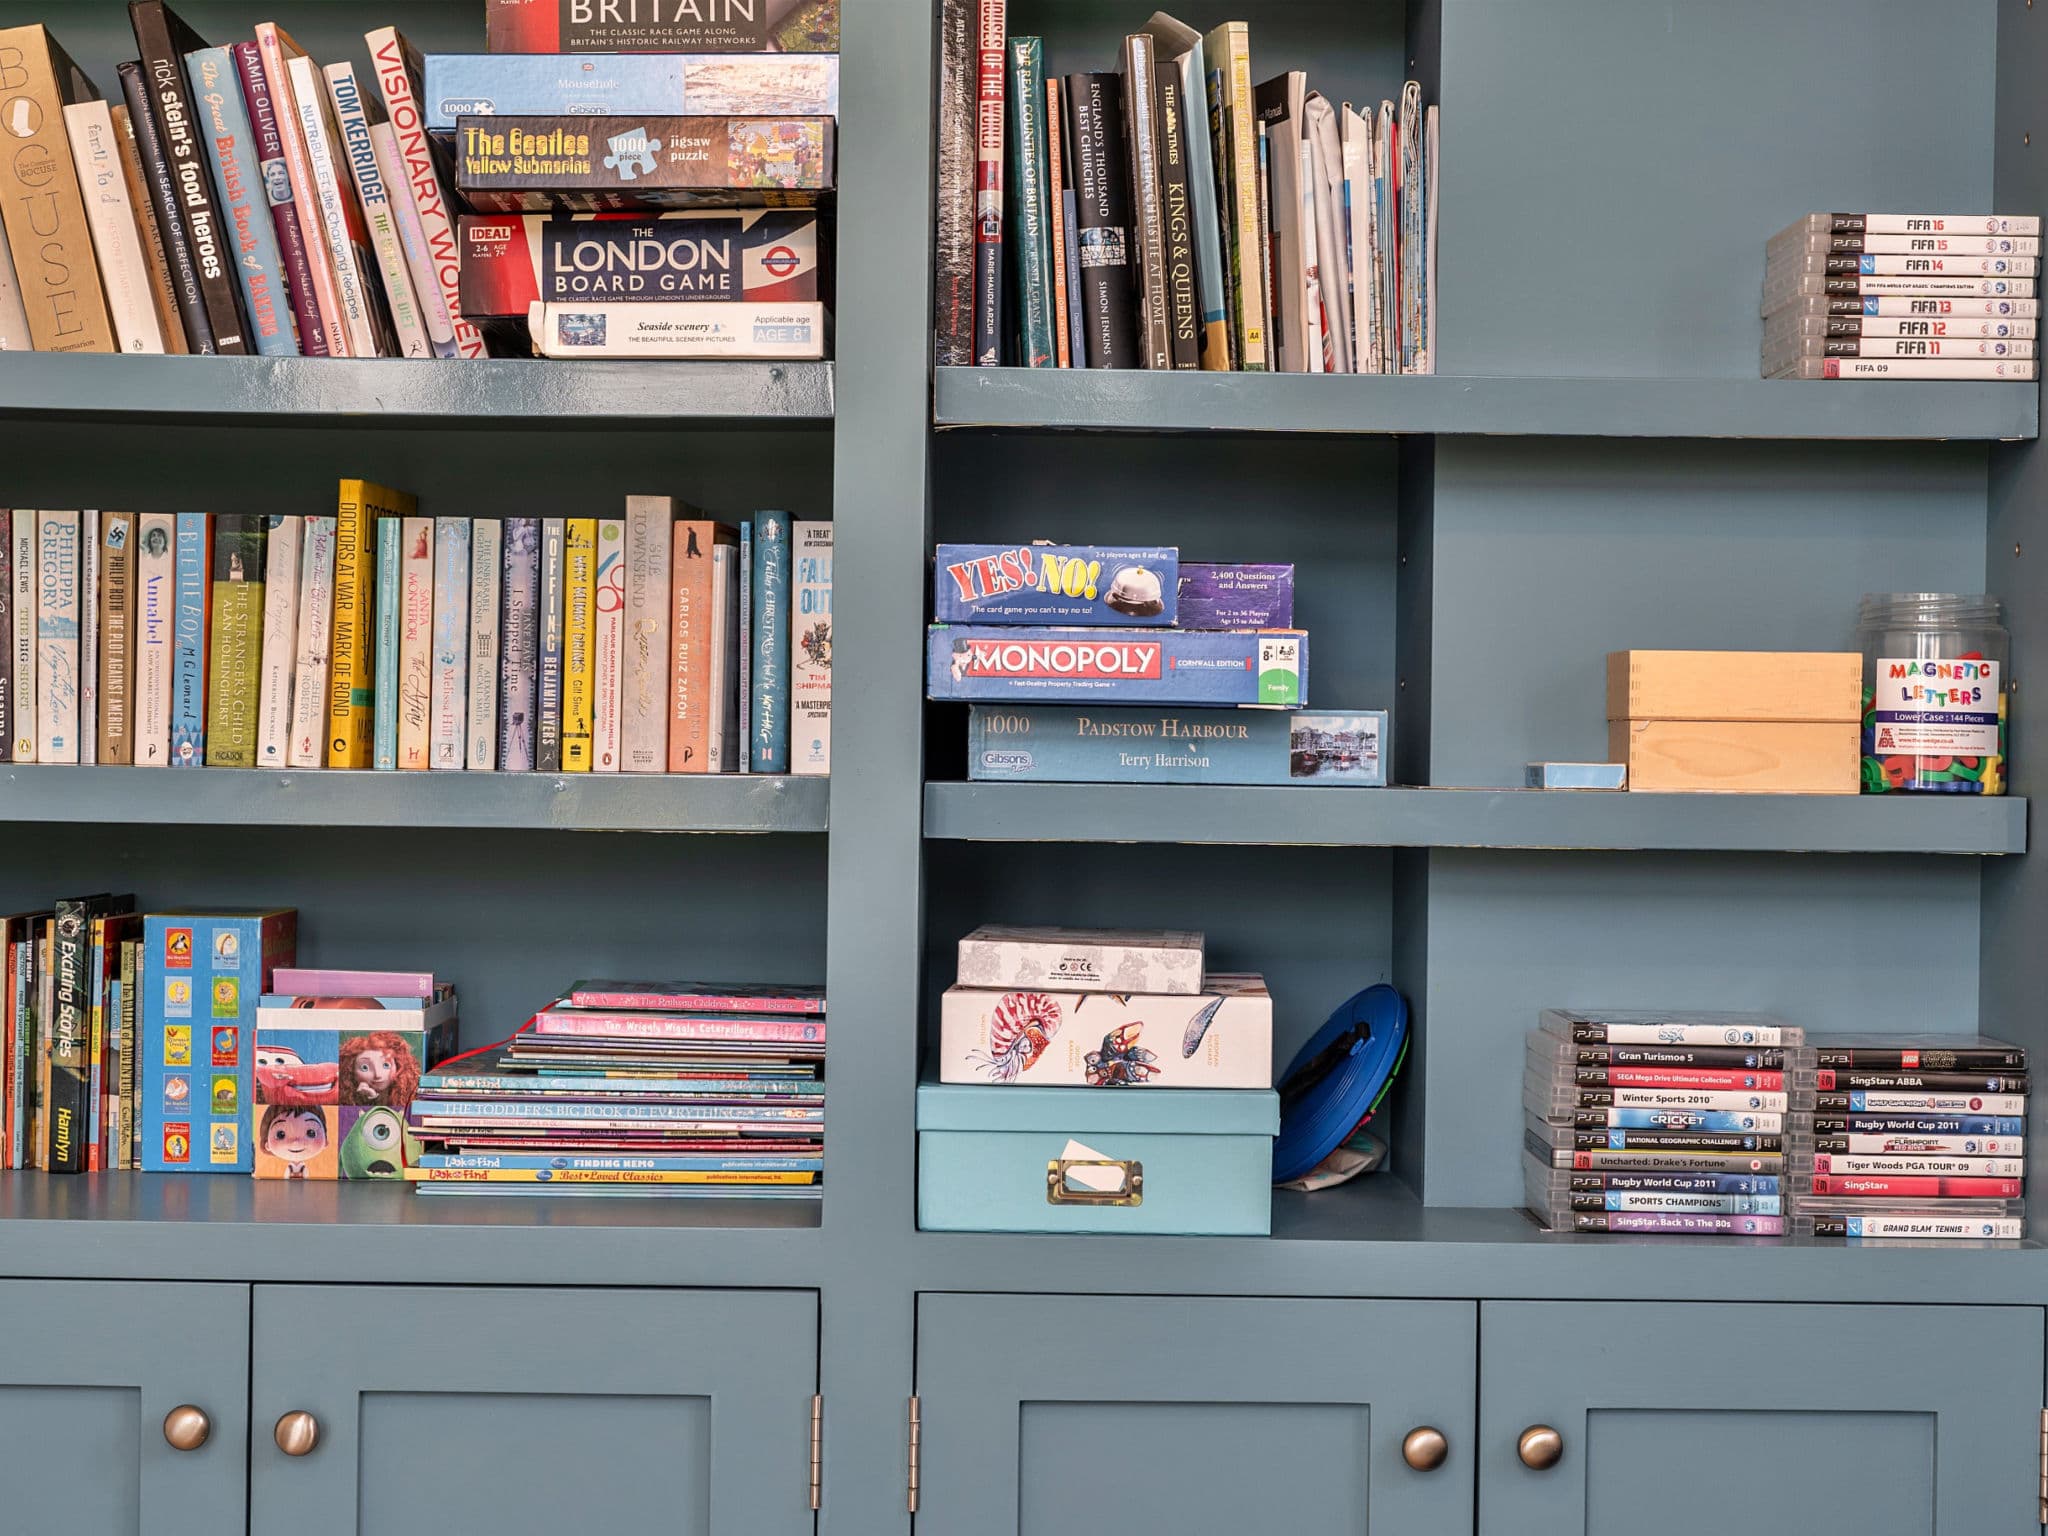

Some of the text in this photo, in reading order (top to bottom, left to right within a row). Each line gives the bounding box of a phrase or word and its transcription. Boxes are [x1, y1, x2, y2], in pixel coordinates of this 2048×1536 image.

[606, 28, 646, 36] CLASSIC
[650, 28, 673, 36] RACE
[676, 28, 702, 36] GAME
[705, 27, 736, 36] ALONG
[571, 37, 756, 46] BRITAIN'S HISTORIC RAILWAY NETWORKS
[243, 46, 281, 153] JAMIE OLIVER
[444, 103, 472, 113] 1000
[1165, 84, 1178, 166] THE TIMES
[332, 73, 387, 208] TOM KERRIDGE
[463, 127, 590, 156] The Beatles
[670, 135, 711, 149] jigsaw
[1090, 83, 1109, 217] ENGLAND'S THOUSAND
[619, 153, 642, 161] piece
[670, 150, 709, 163] puzzle
[1079, 105, 1095, 200] BEST CHURCHES
[152, 59, 221, 279] rick stein's food heroes
[466, 155, 591, 174] Yellow Submarine
[633, 228, 654, 238] THE
[1907, 220, 1944, 231] FIFA 16
[1911, 240, 1948, 250] FIFA 15
[555, 239, 730, 273] LONDON
[1168, 182, 1194, 340] KINGS & QUEENS
[1906, 260, 1943, 271] FIFA 14
[555, 273, 732, 292] BOARD GAME
[986, 249, 995, 335] MARIE-HAUDE ARZUR
[637, 321, 711, 334] Seaside scenery
[755, 315, 811, 325] Applicable age
[1098, 281, 1112, 355] SIMON JENKINS
[547, 526, 560, 535] THE
[20, 538, 29, 594] MICHAEL LEWIS
[43, 521, 60, 610] GREGORY
[60, 524, 76, 609] PHILIPPA
[632, 512, 648, 608] TOWNSEND
[947, 547, 1102, 602] YES! NO!
[1211, 571, 1276, 581] 2,400 Questions
[1219, 581, 1268, 590] and Answers
[333, 502, 358, 717] DOCTORS AT WAR MARK DE ROND
[419, 589, 429, 626] SANTA
[971, 605, 985, 614] The
[986, 605, 1003, 614] card
[1004, 606, 1023, 615] game
[1024, 606, 1038, 615] you
[1039, 605, 1056, 614] can't
[1058, 607, 1070, 615] say
[1082, 606, 1093, 614] to!
[107, 556, 125, 738] PHILIP ROTH THE PLOT AGAINST AMERICA
[521, 611, 532, 672] JANE DAVIS
[217, 600, 233, 727] ALAN HOLLINGHURST
[231, 582, 250, 745] THE STRANGER'S CHILD
[973, 645, 1155, 673] MONOPOLY
[1178, 660, 1244, 668] CORNWALL EDITION
[20, 638, 29, 711] BIG SHORT
[1889, 661, 1990, 680] MAGNETIC
[1268, 684, 1290, 692] Family
[1901, 684, 1982, 707] LETTERS
[300, 675, 311, 723] ROBERTS
[312, 680, 321, 718] SHEILA
[542, 657, 557, 746] BENJAMIN MYERS
[985, 715, 1030, 734] 1000
[215, 751, 243, 761] PICADOR
[1119, 752, 1210, 769] Terry Harrison
[58, 941, 77, 1058] Exciting Stories
[658, 998, 690, 1008] Railway
[694, 999, 729, 1008] Children
[604, 1021, 754, 1034] Ten Wriggly Wiggly Caterpillars
[1622, 1094, 1710, 1104] Winter Sports 2010
[1650, 1115, 1705, 1125] CRICKET
[1855, 1121, 1885, 1131] Rugby
[1887, 1121, 1915, 1129] World
[1917, 1122, 1935, 1131] Cup
[56, 1107, 72, 1162] Hamlyn
[477, 1157, 500, 1167] Find
[574, 1159, 655, 1168] FINDING NEMO
[1600, 1158, 1726, 1168] Uncharted: Drake's Fortune
[463, 1170, 488, 1180] Find
[560, 1171, 664, 1181] Best Loved Classics
[1612, 1178, 1716, 1188] Rugby World Cup 2011
[1629, 1197, 1722, 1207] SPORTS CHAMPIONS
[1883, 1224, 1909, 1232] GRAND
[1911, 1224, 1931, 1232] SLAM
[1935, 1225, 1962, 1233] TENNIS
